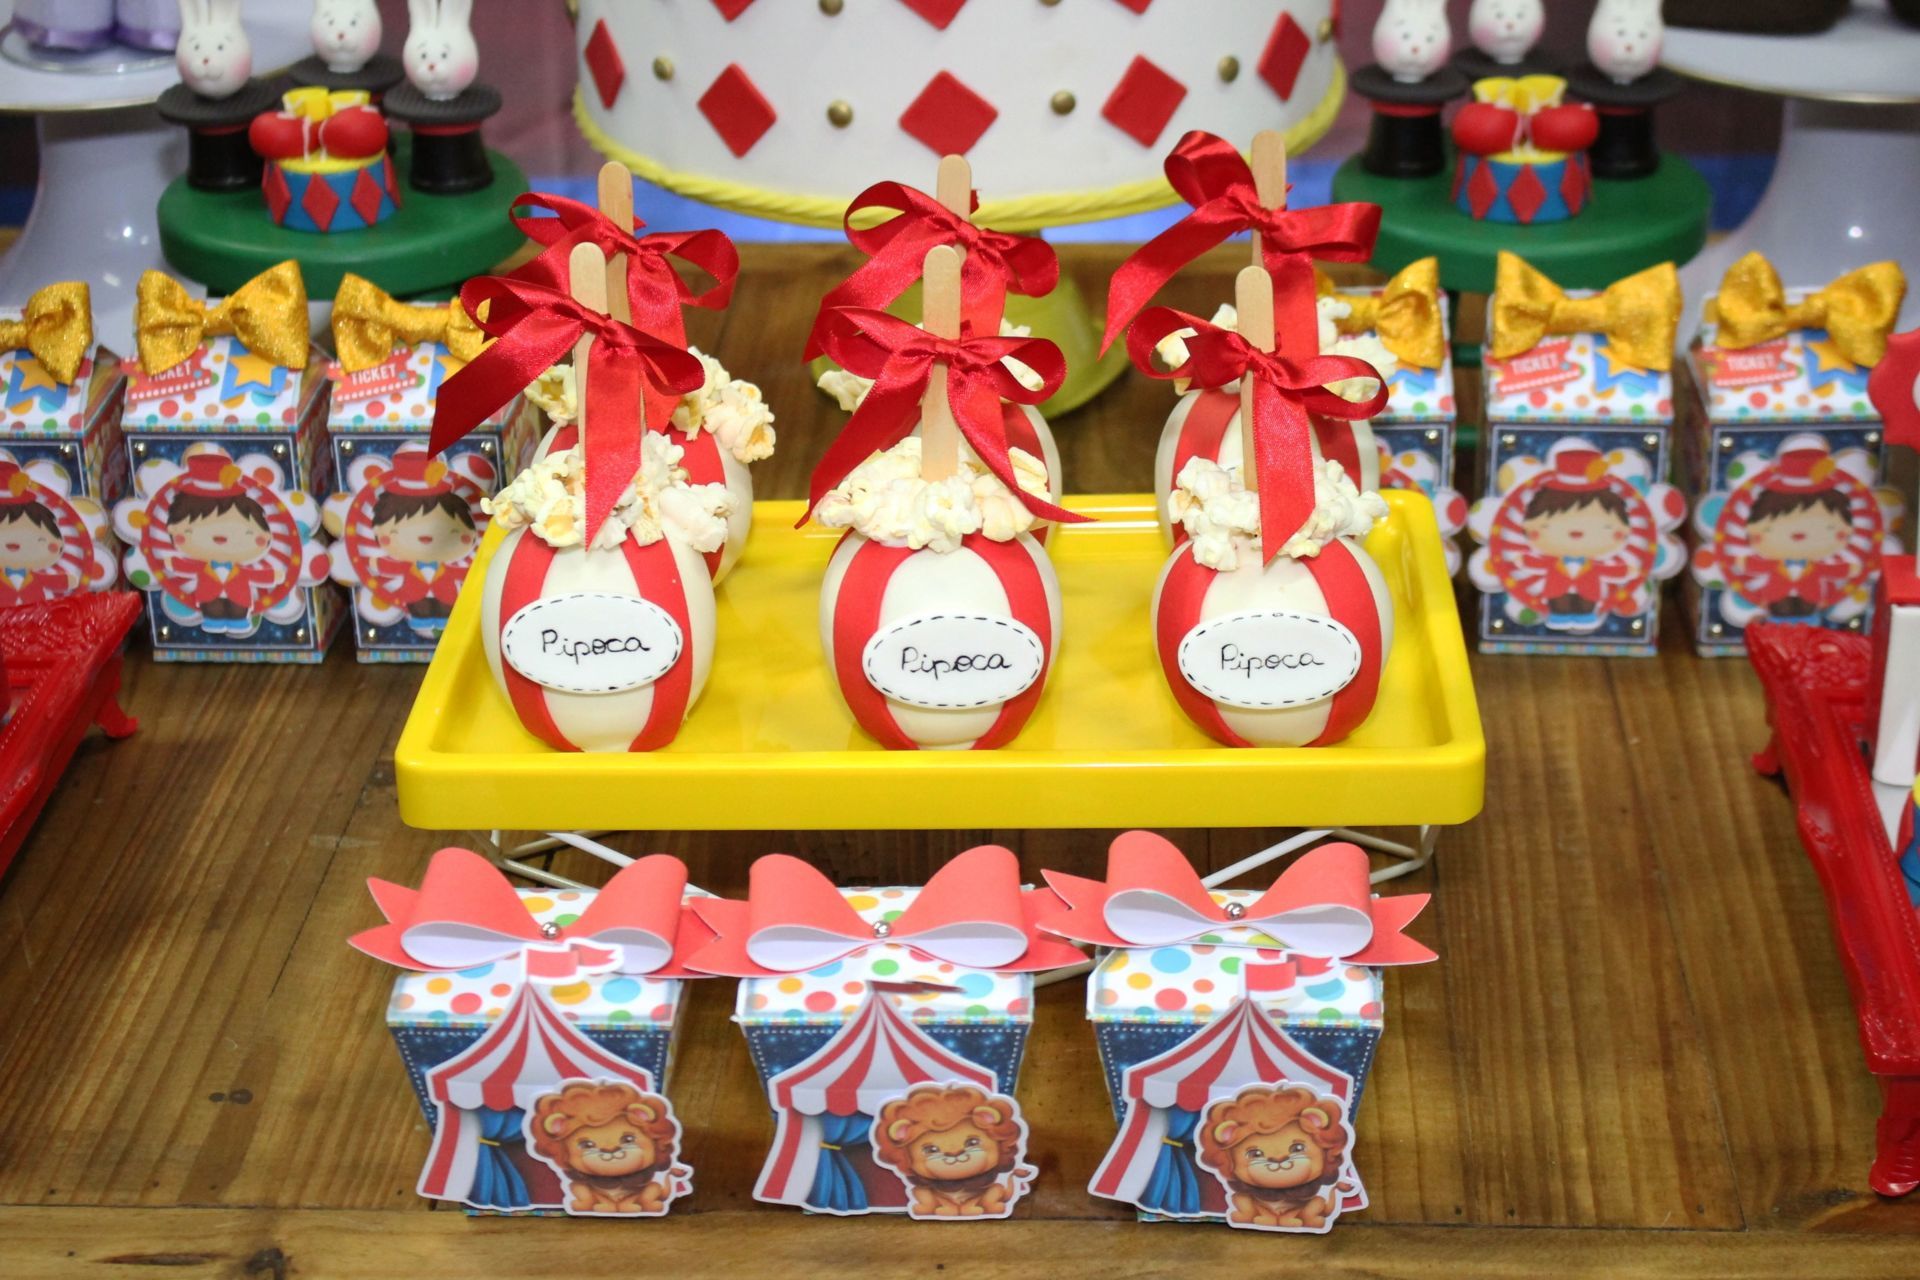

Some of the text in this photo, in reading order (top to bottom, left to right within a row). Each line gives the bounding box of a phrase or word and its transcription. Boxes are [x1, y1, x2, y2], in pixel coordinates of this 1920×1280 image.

[351, 363, 396, 386] TICKET
[1510, 352, 1557, 375] TICKET
[1726, 352, 1774, 372] TICKET
[541, 629, 651, 664] Pipoca
[1221, 643, 1325, 678] Pipoca
[901, 646, 1012, 680] Pipoca
